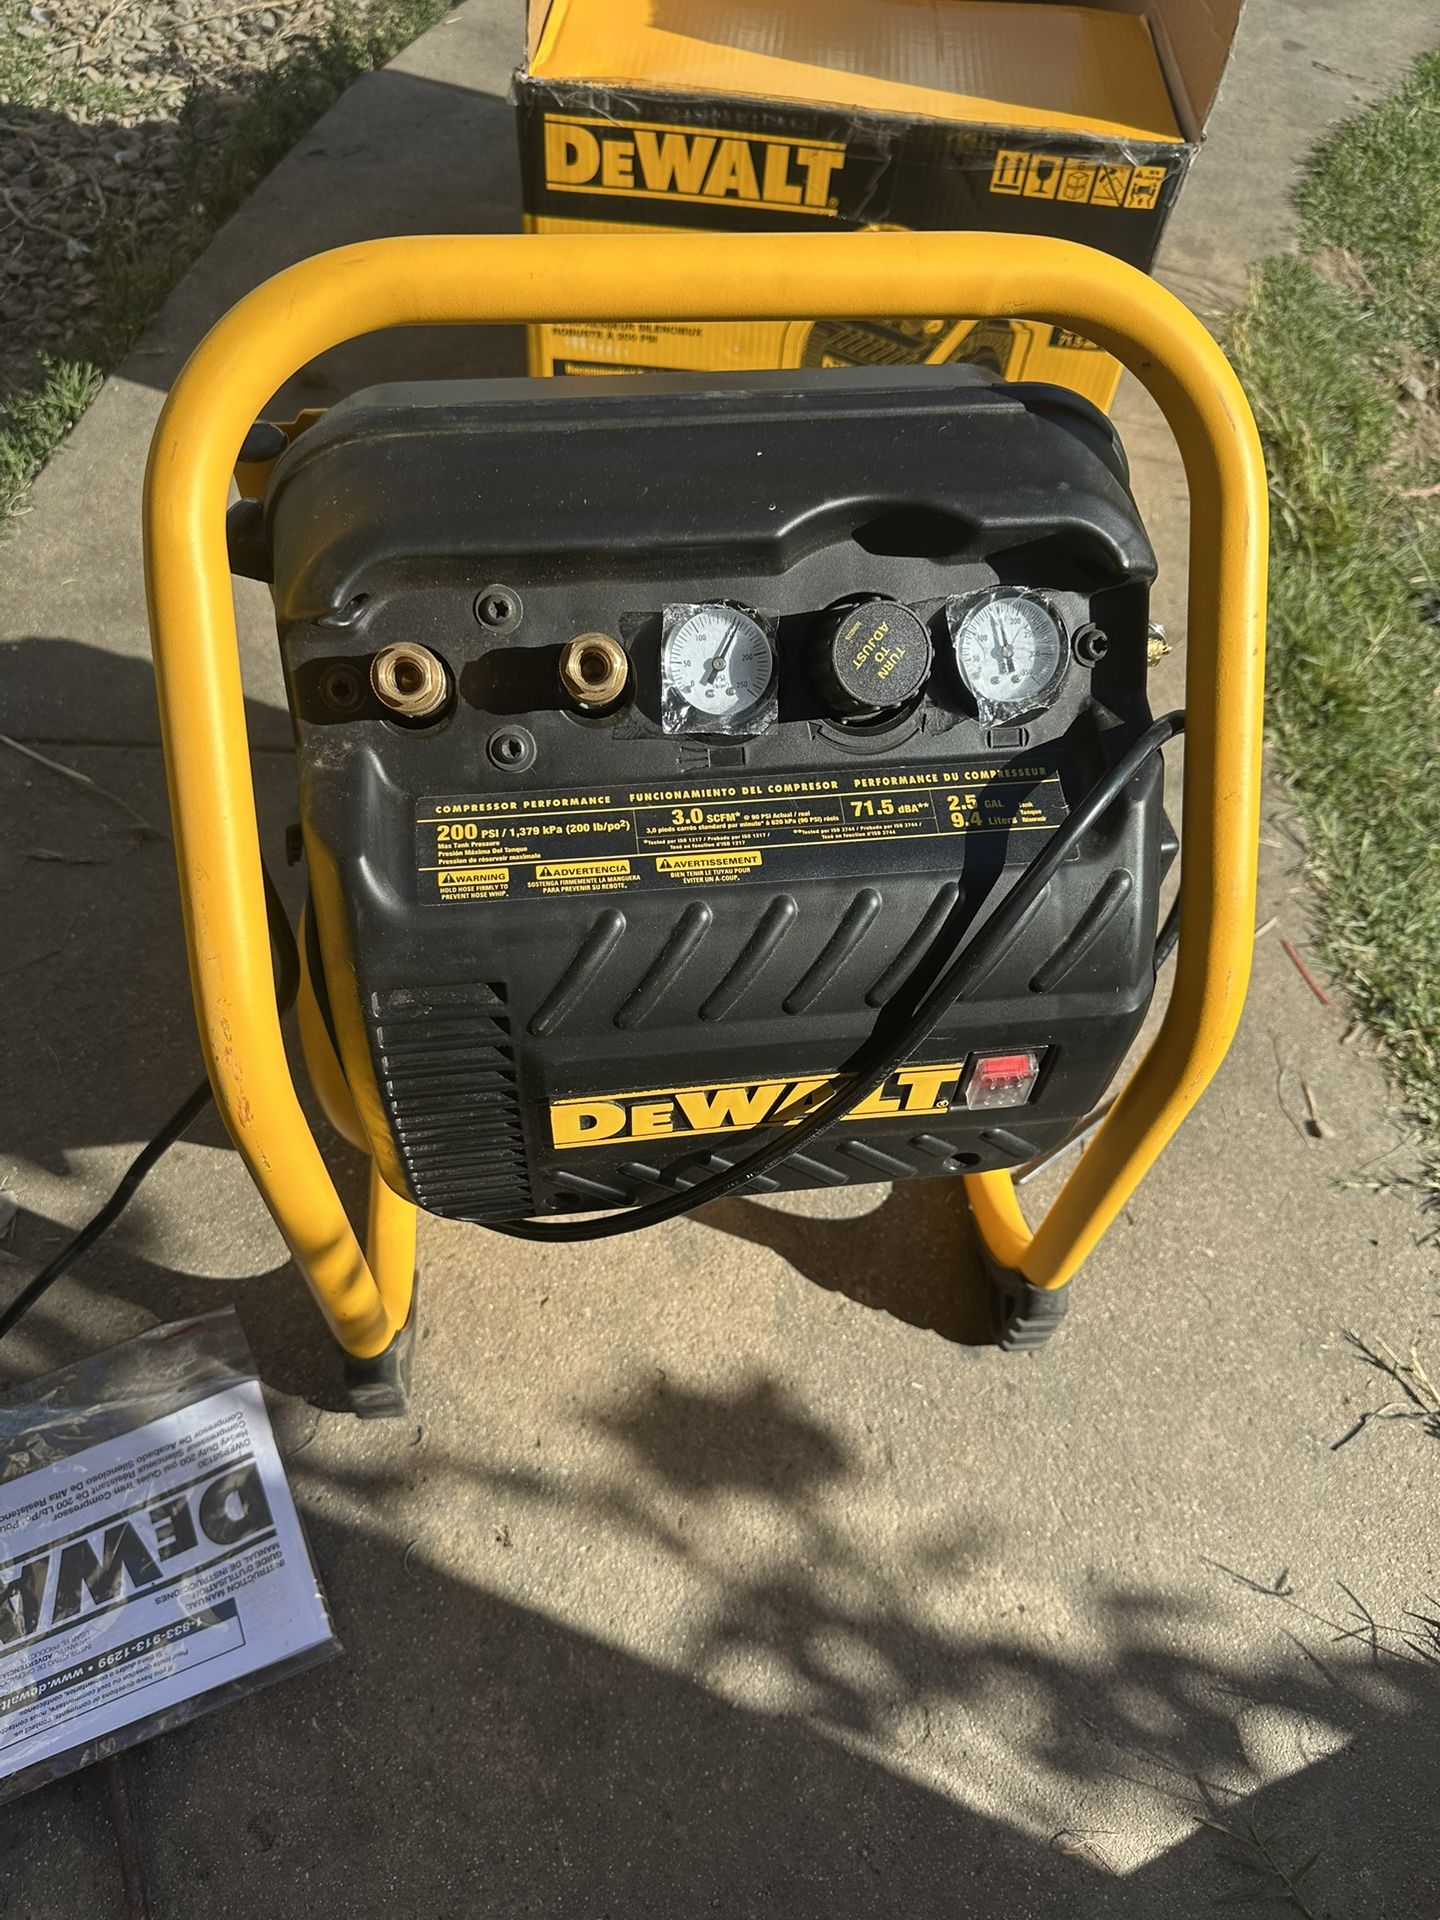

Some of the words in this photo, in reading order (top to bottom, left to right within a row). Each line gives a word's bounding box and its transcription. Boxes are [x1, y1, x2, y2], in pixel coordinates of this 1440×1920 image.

[545, 122, 845, 207] DEWALT
[618, 333, 638, 342] 200
[640, 334, 658, 344] PSI
[695, 634, 707, 642] 100
[852, 621, 889, 670] ADJUST
[742, 653, 754, 661] 200
[874, 646, 890, 663] TO
[877, 647, 906, 680] TURN
[736, 681, 748, 689] 250
[853, 774, 939, 788] PERFORMANCE
[943, 772, 959, 782] DU
[964, 767, 1046, 781] COMPRESSEUR
[629, 787, 736, 802] FUNCIONAMIENTO
[741, 785, 763, 795] DEL
[767, 781, 839, 793] COMPRESOR
[435, 801, 518, 814] COMPRESSOR
[523, 796, 611, 809] PERFORMANCE
[850, 799, 895, 818] 71.5
[946, 794, 978, 811] 2.5
[984, 799, 1005, 809] GAL
[671, 808, 704, 825] 3.0
[772, 811, 793, 819] Actual
[950, 811, 983, 828] 9.4
[988, 816, 1018, 825] Liters
[436, 823, 478, 842] 200
[481, 828, 499, 839] PSI
[501, 829, 507, 838] /
[509, 826, 540, 838] 1,379
[543, 823, 563, 835] kPa
[565, 822, 590, 835] (200
[592, 819, 631, 833] lb/po²)
[646, 827, 657, 835] 3,0
[657, 826, 676, 834] pieds
[698, 822, 727, 831] standard
[809, 816, 823, 824] PSI)
[470, 840, 501, 848] Pressure
[504, 846, 528, 854] Tanque
[438, 857, 468, 865] Pression
[673, 856, 758, 869] AVERTISSEMENT
[455, 873, 506, 883] WARNING
[553, 865, 628, 877] ADVERTENCIA
[439, 886, 457, 894] HOLD
[458, 885, 475, 893] HOSE
[476, 884, 499, 892] FIRMLY
[527, 880, 559, 888] SOSTENGA
[559, 878, 598, 886] FIRMEMENTE
[607, 874, 641, 883] MANGUERA
[488, 890, 509, 898] WHIP.
[191, 1409, 244, 1439] Compresor
[177, 1433, 193, 1446] De
[184, 1418, 247, 1452] Compresseur
[134, 1440, 178, 1465] Acabado
[196, 1441, 220, 1458] Duty
[135, 1447, 185, 1474] Silencieux
[161, 1460, 179, 1474] psi
[177, 1452, 197, 1467] 200
[84, 1458, 136, 1487] Silencioso
[135, 1468, 163, 1486] Quiet
[68, 1480, 84, 1493] De
[89, 1468, 137, 1495] Résistant
[112, 1480, 135, 1496] Trim
[46, 1487, 70, 1503] Alta
[54, 1495, 75, 1510] 200
[74, 1489, 90, 1501] De
[50, 1489, 113, 1522] Compressor
[241, 1540, 281, 1565] MANUAL
[253, 1549, 284, 1569] GUIDE
[227, 1559, 243, 1571] DE
[225, 1558, 286, 1593] INSTRUCTION
[184, 1586, 227, 1611] MANUAL
[95, 1615, 204, 1669] 1-833-913-1299
[121, 1663, 153, 1682] question
[135, 1672, 153, 1685] have
[153, 1665, 168, 1676] you
[95, 1681, 112, 1693] tout
[100, 1680, 136, 1700] questions
[91, 1695, 101, 1703] or
[28, 1709, 48, 1722] nous
[22, 1716, 53, 1734] contact
